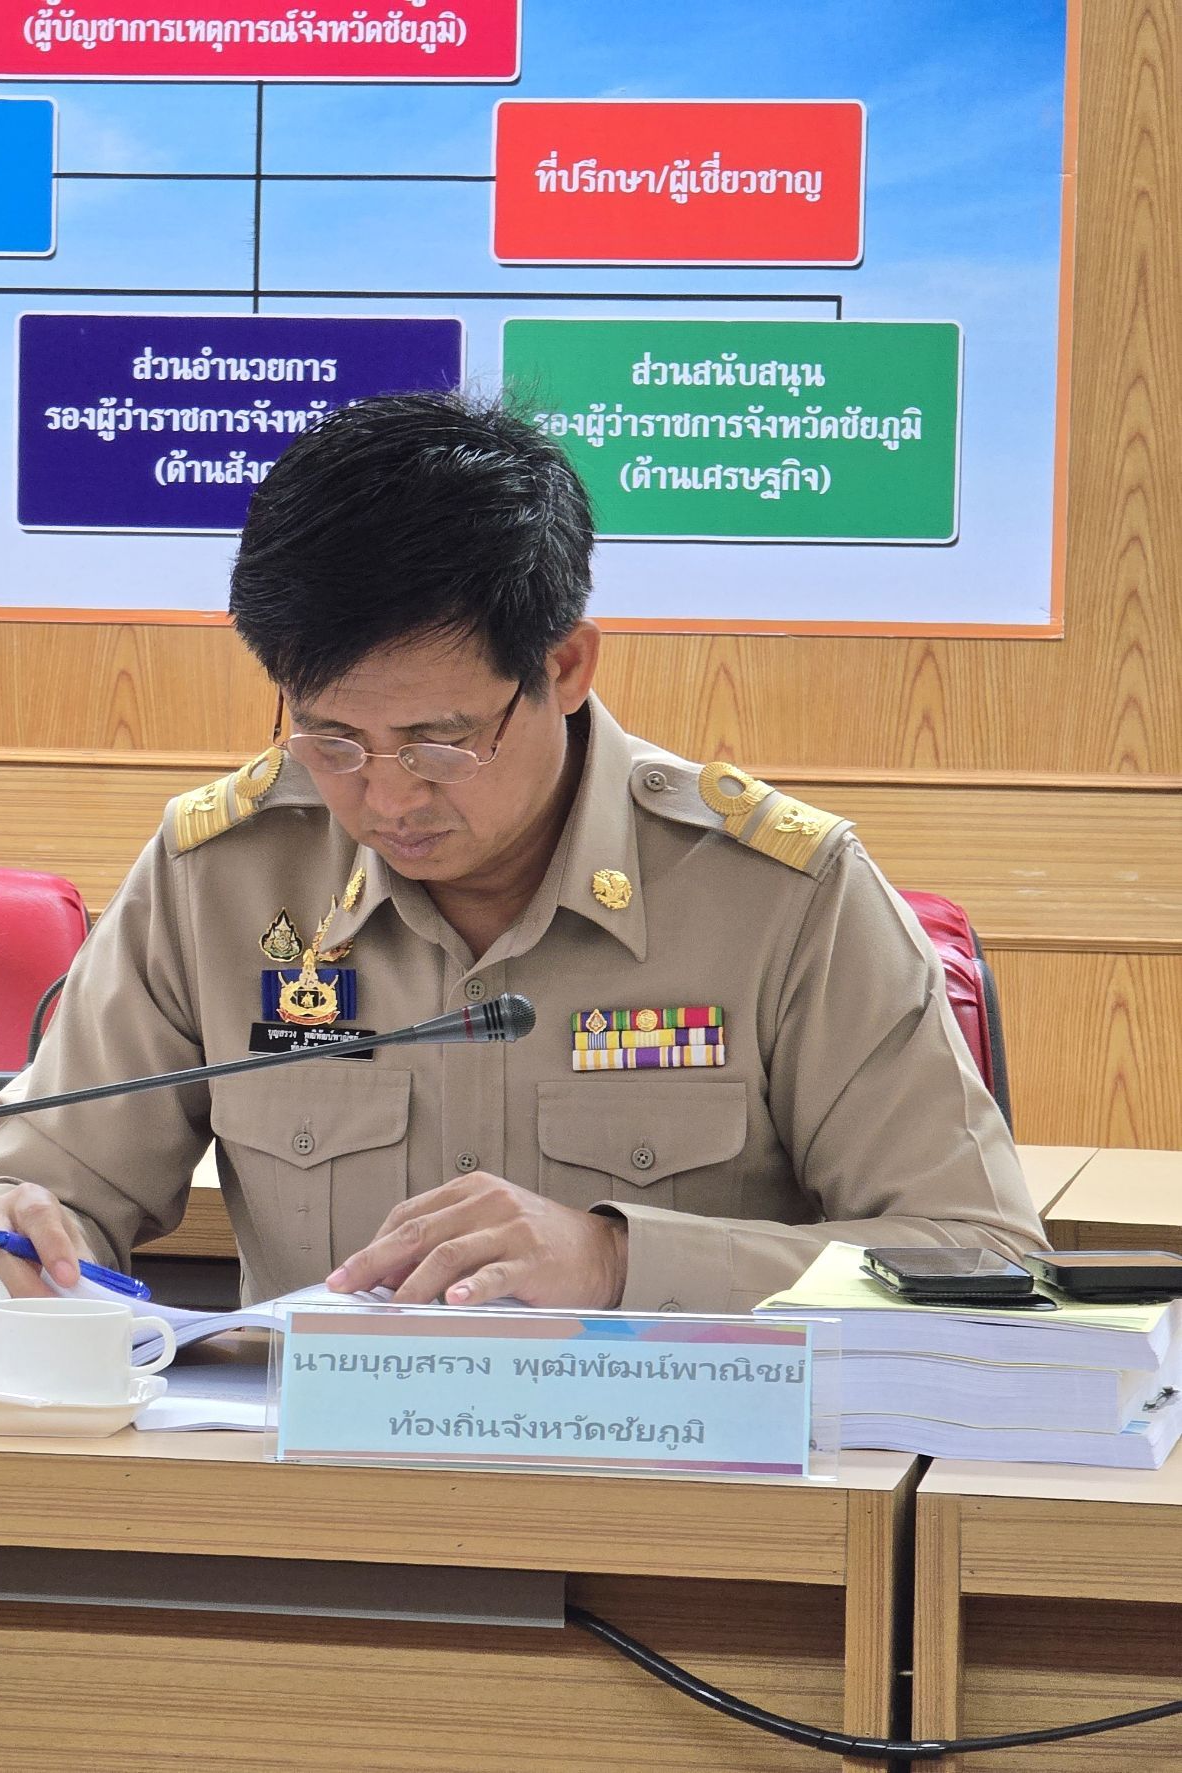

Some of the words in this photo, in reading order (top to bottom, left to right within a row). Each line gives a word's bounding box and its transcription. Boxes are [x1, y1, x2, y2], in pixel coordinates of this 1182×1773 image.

[23, 11, 467, 53] (ผู้บัญชาการเหตุการณ์จังหวัดชัยภูมิ)
[535, 151, 822, 204] ที่ปรึกษา/ผู้เชี่ยวชาญ
[133, 347, 337, 382] ส่วนอำนวยการ
[631, 353, 825, 396] ส่วนสนับสนุน
[533, 403, 922, 450] รองผู้ว่าราชการจังหวัดชัยภูมิ
[620, 455, 831, 500] (ด้านเศรษฐกิจ)
[293, 1350, 492, 1381] นายบุญสรวง
[512, 1352, 806, 1384] พุฒิพัฒน์พาณิชย์
[388, 1405, 706, 1451] ท้องถิ่นจังหวัดชัยภูมิ
